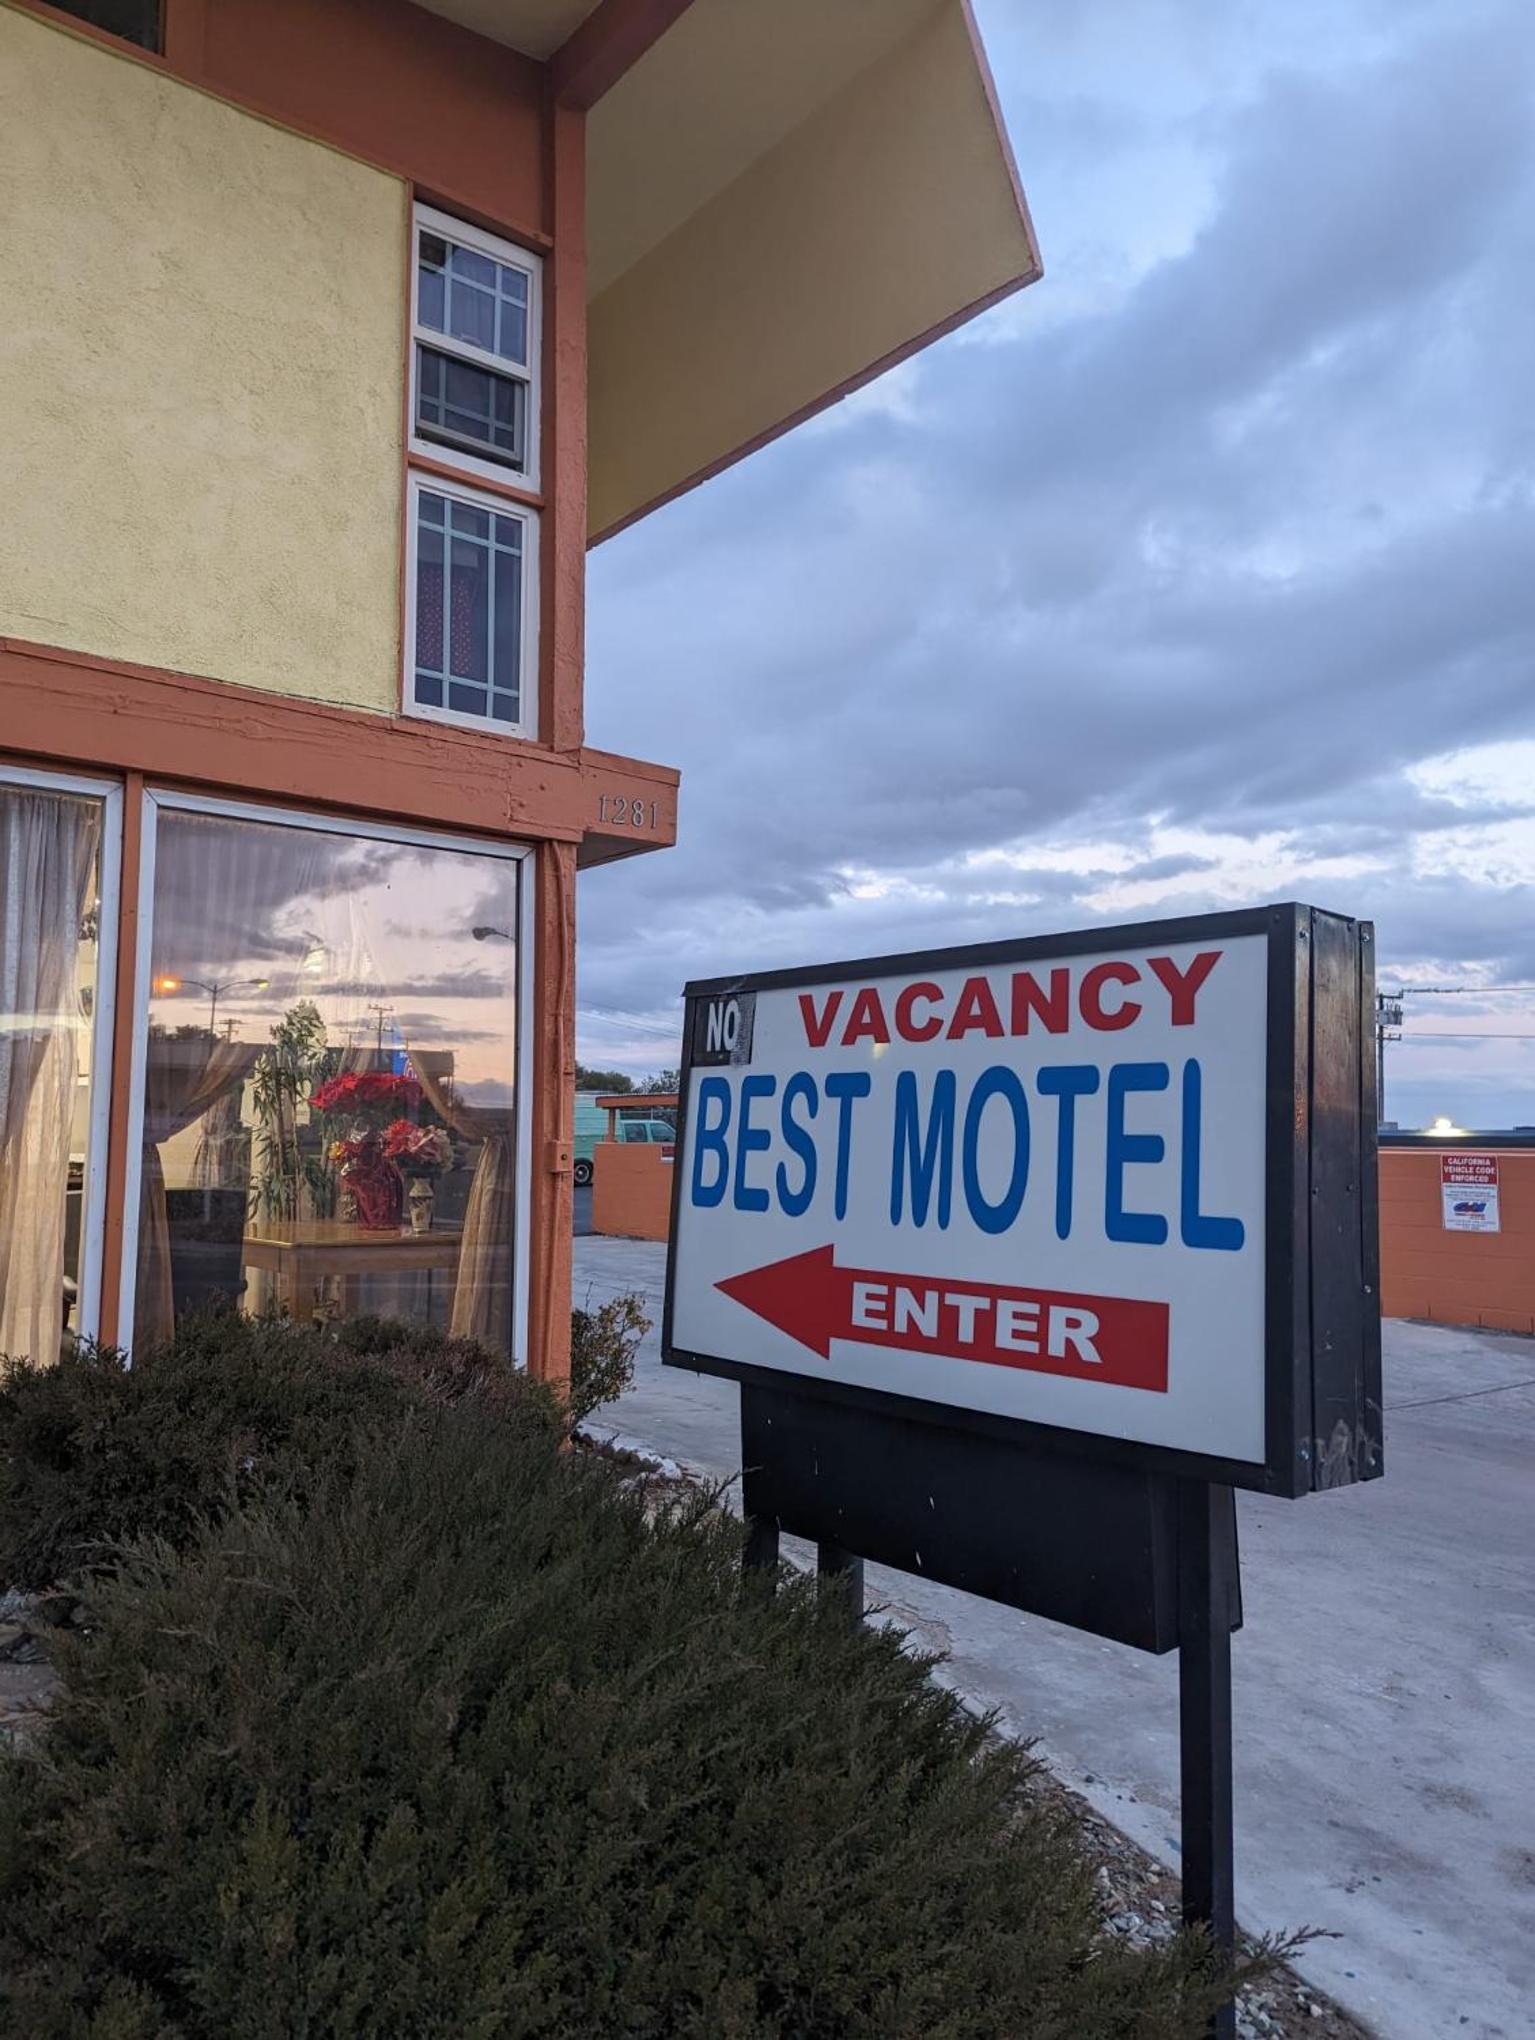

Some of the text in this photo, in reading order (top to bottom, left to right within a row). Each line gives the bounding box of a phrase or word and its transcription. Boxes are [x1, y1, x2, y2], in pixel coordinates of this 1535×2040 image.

[600, 794, 657, 829] 1281
[706, 951, 1223, 1052] NO VACANCY
[691, 1057, 1245, 1252] BEST MOTEL
[1444, 1166, 1474, 1174] VEHICLE
[1447, 1157, 1491, 1166] CALIFORNIA
[851, 1282, 1103, 1364] ENTER
